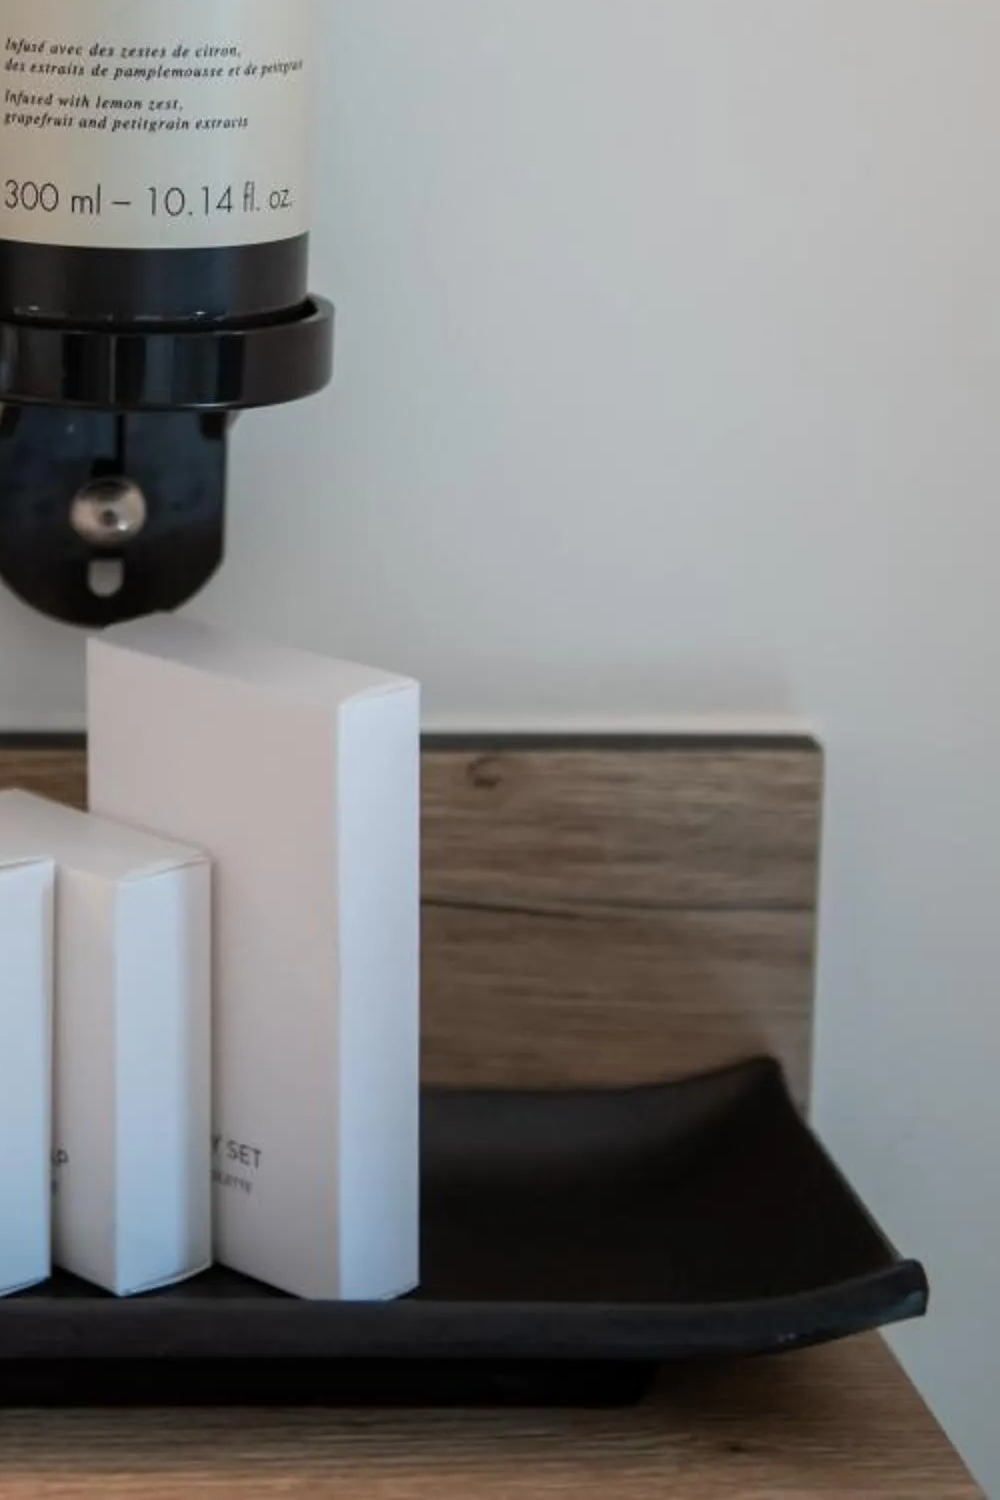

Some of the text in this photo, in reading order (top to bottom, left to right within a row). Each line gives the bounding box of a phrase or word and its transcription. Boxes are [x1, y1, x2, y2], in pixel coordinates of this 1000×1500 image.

[5, 37, 45, 56] Infusé
[50, 42, 83, 56] avec
[89, 43, 114, 58] des
[120, 44, 167, 59] zestes
[172, 42, 189, 58] de
[5, 58, 26, 72] des
[30, 61, 85, 76] extraits
[91, 62, 109, 78] de
[113, 63, 223, 80] pamplemousse
[228, 62, 240, 77] et
[244, 60, 258, 76] de
[5, 89, 53, 107] Infused
[57, 93, 90, 109] with
[96, 95, 142, 111] lemon
[4, 112, 249, 133] grapefruit and petitgrain extracts
[5, 179, 59, 212] 300
[70, 185, 101, 214] ml
[148, 185, 233, 216] 10.14
[242, 180, 261, 212] fl.
[226, 1139, 261, 1169] SET
